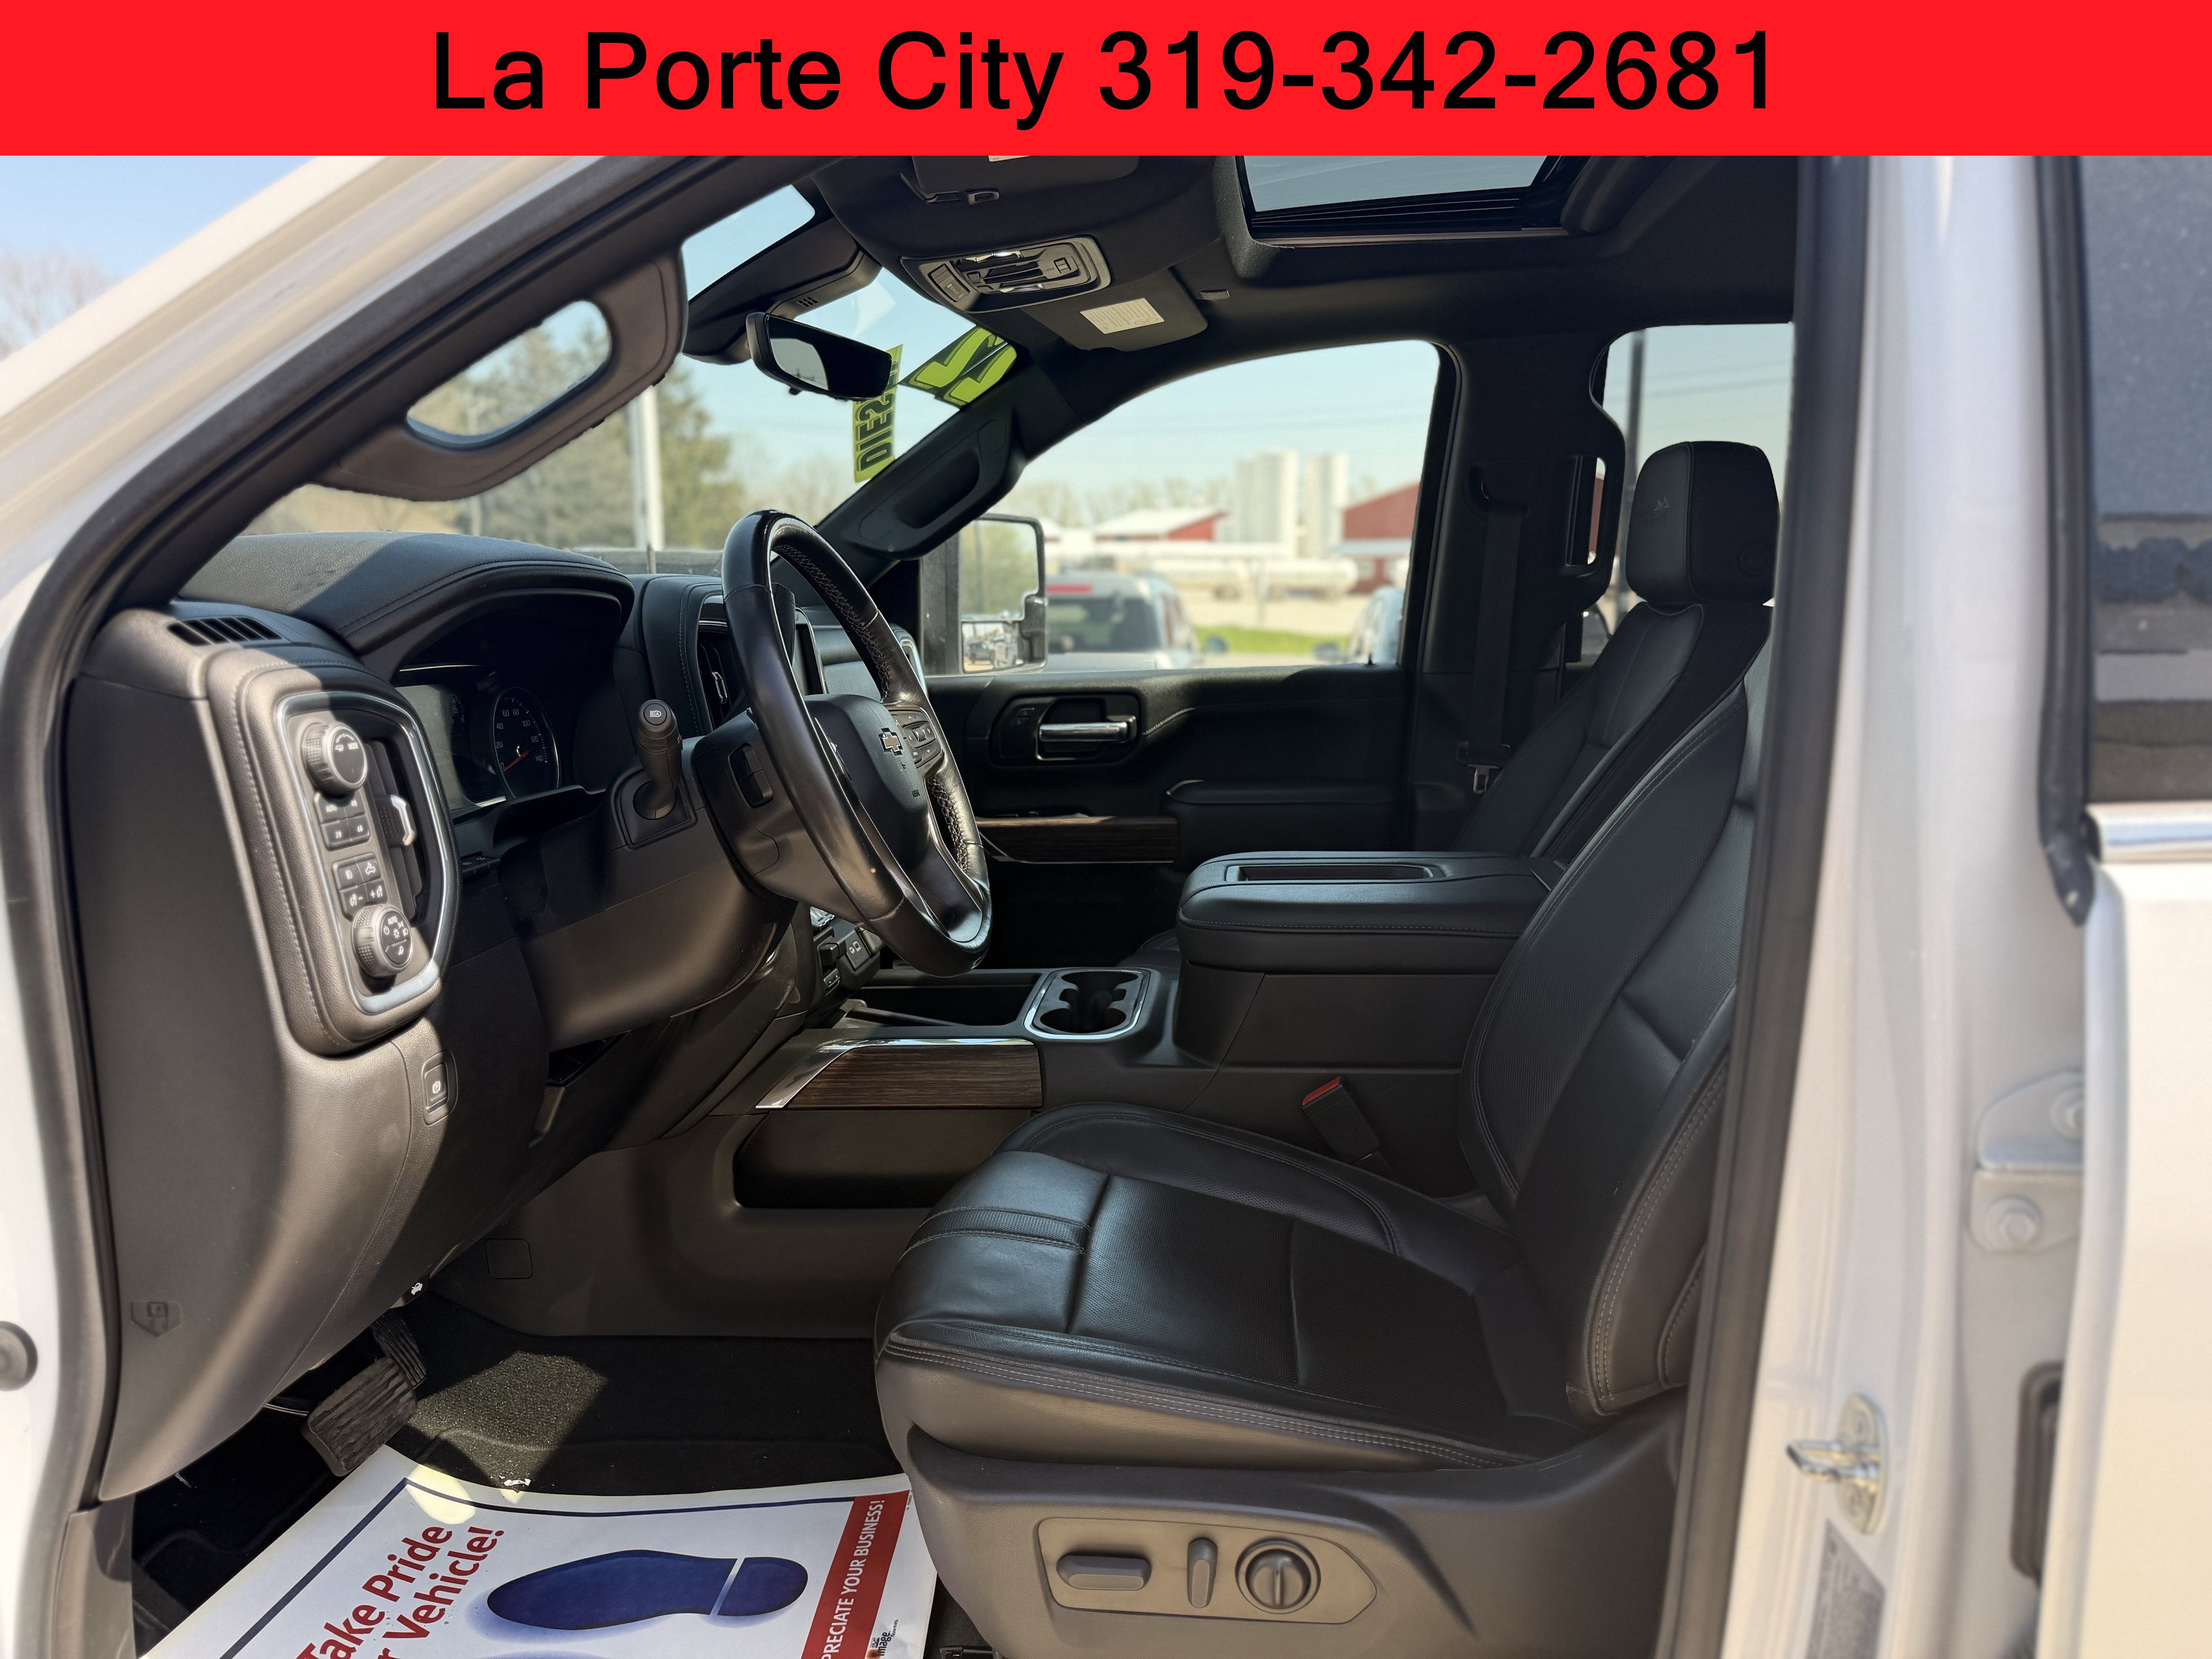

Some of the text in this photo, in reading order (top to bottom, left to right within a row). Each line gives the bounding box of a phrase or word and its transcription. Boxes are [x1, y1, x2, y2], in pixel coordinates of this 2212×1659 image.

[388, 916, 398, 925] AUTO
[361, 1527, 452, 1602] Pride
[382, 1526, 504, 1638] Vehicle!
[841, 1558, 866, 1595] YOUR
[854, 1500, 885, 1557] BUSINESS!
[878, 1631, 891, 1656] image
